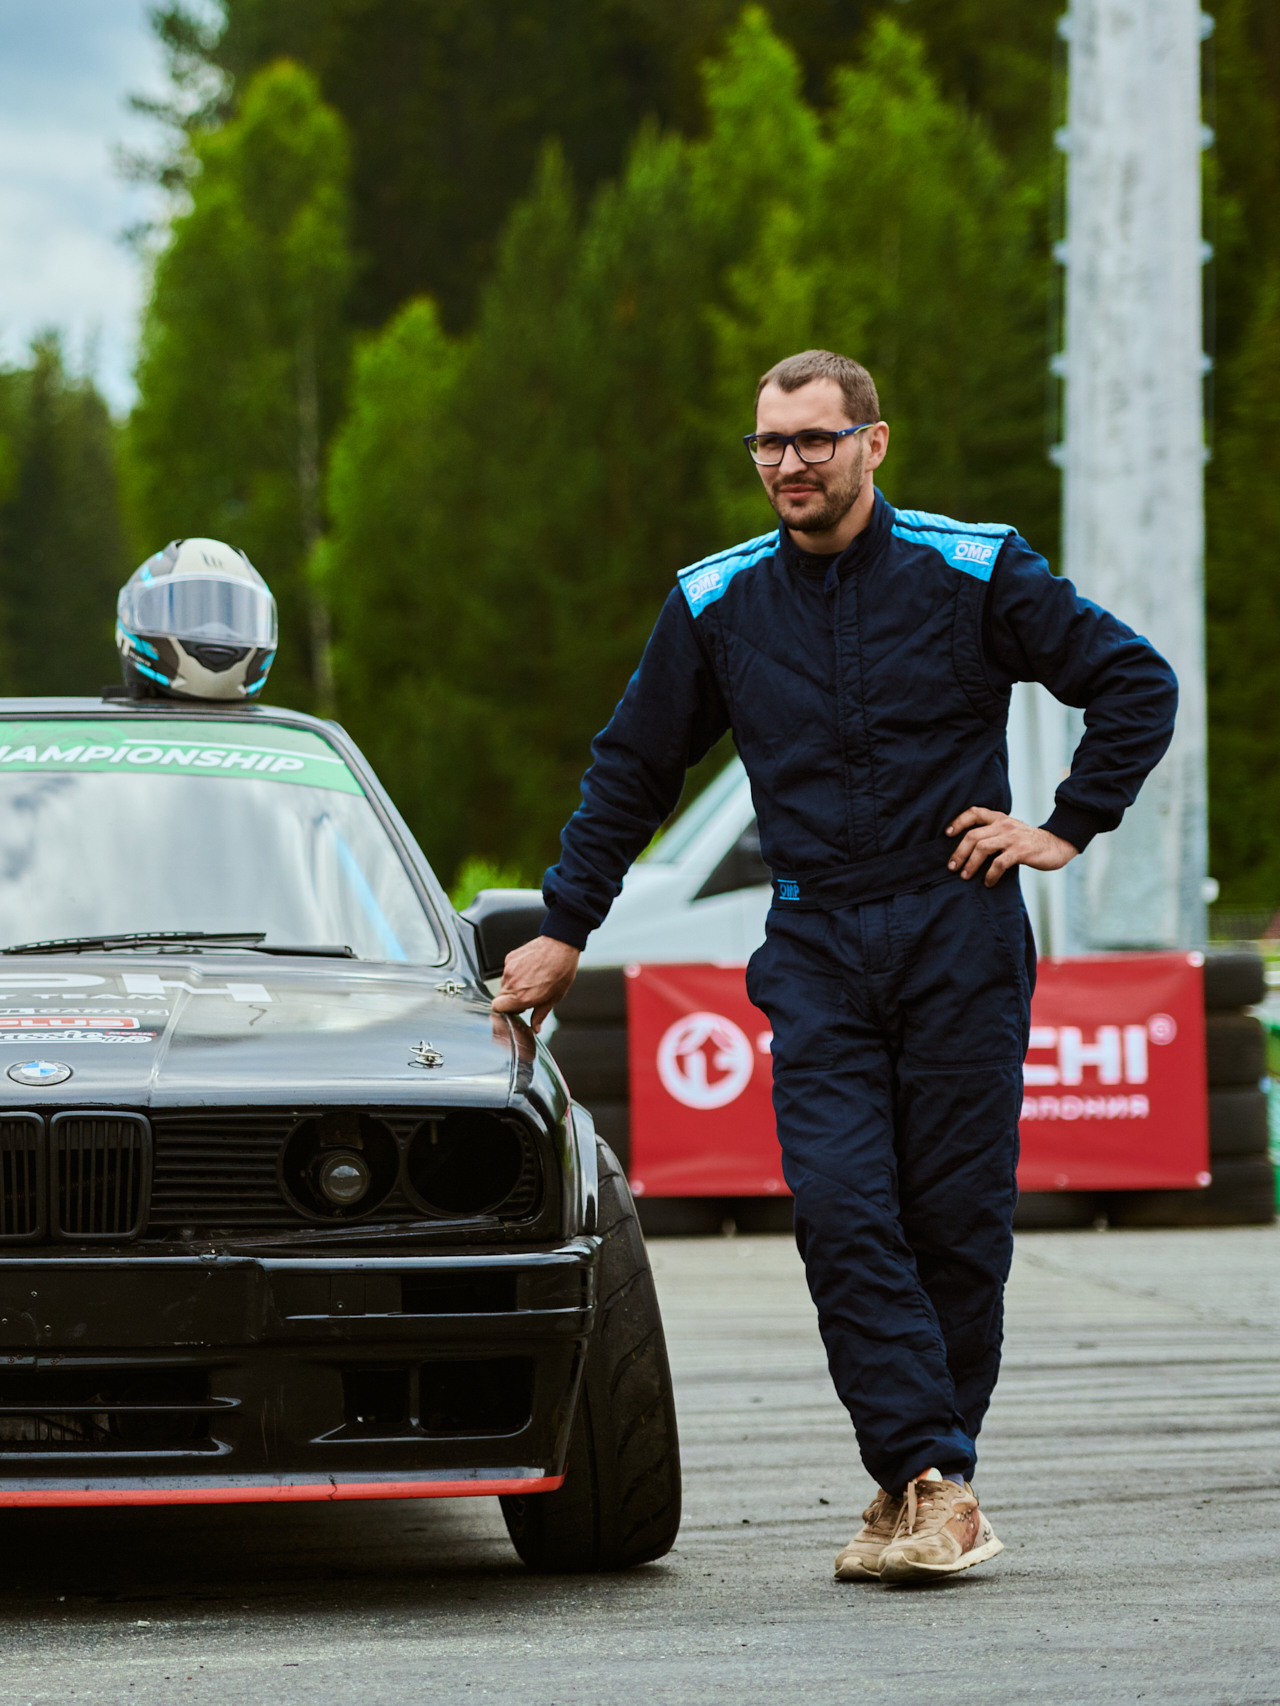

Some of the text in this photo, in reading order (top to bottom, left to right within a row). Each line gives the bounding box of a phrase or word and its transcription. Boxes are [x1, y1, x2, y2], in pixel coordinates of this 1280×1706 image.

[955, 543, 993, 561] OMP
[688, 573, 720, 598] OMP
[780, 883, 800, 898] OMP
[32, 993, 167, 1001] TEAM
